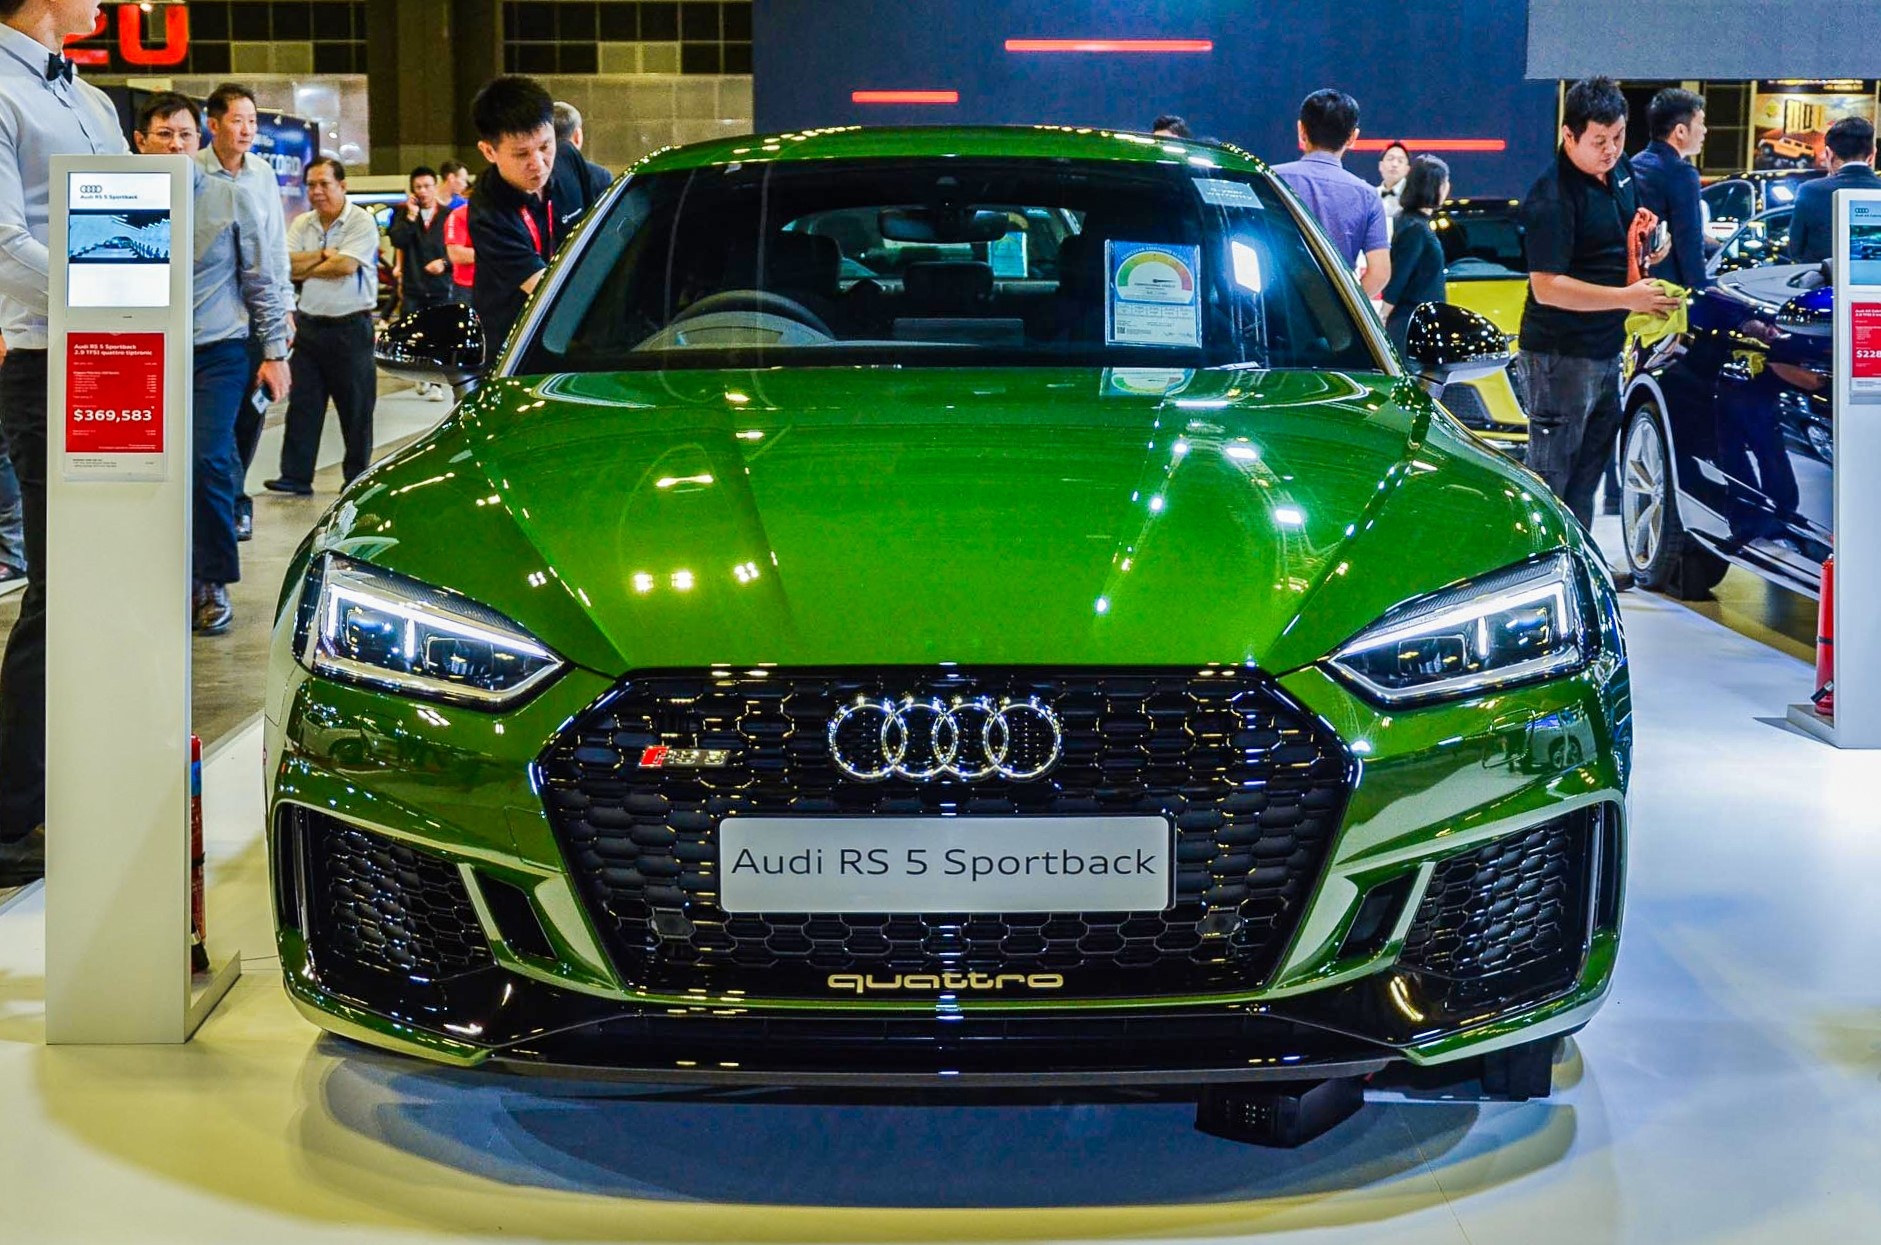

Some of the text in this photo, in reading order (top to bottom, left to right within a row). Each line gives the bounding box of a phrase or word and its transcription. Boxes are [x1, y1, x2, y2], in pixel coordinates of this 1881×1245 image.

[105, 344, 137, 352] Sportback
[73, 408, 152, 423] $369,583
[732, 848, 1156, 882] Audi RS 5 Sportback
[826, 971, 1064, 994] quattro
